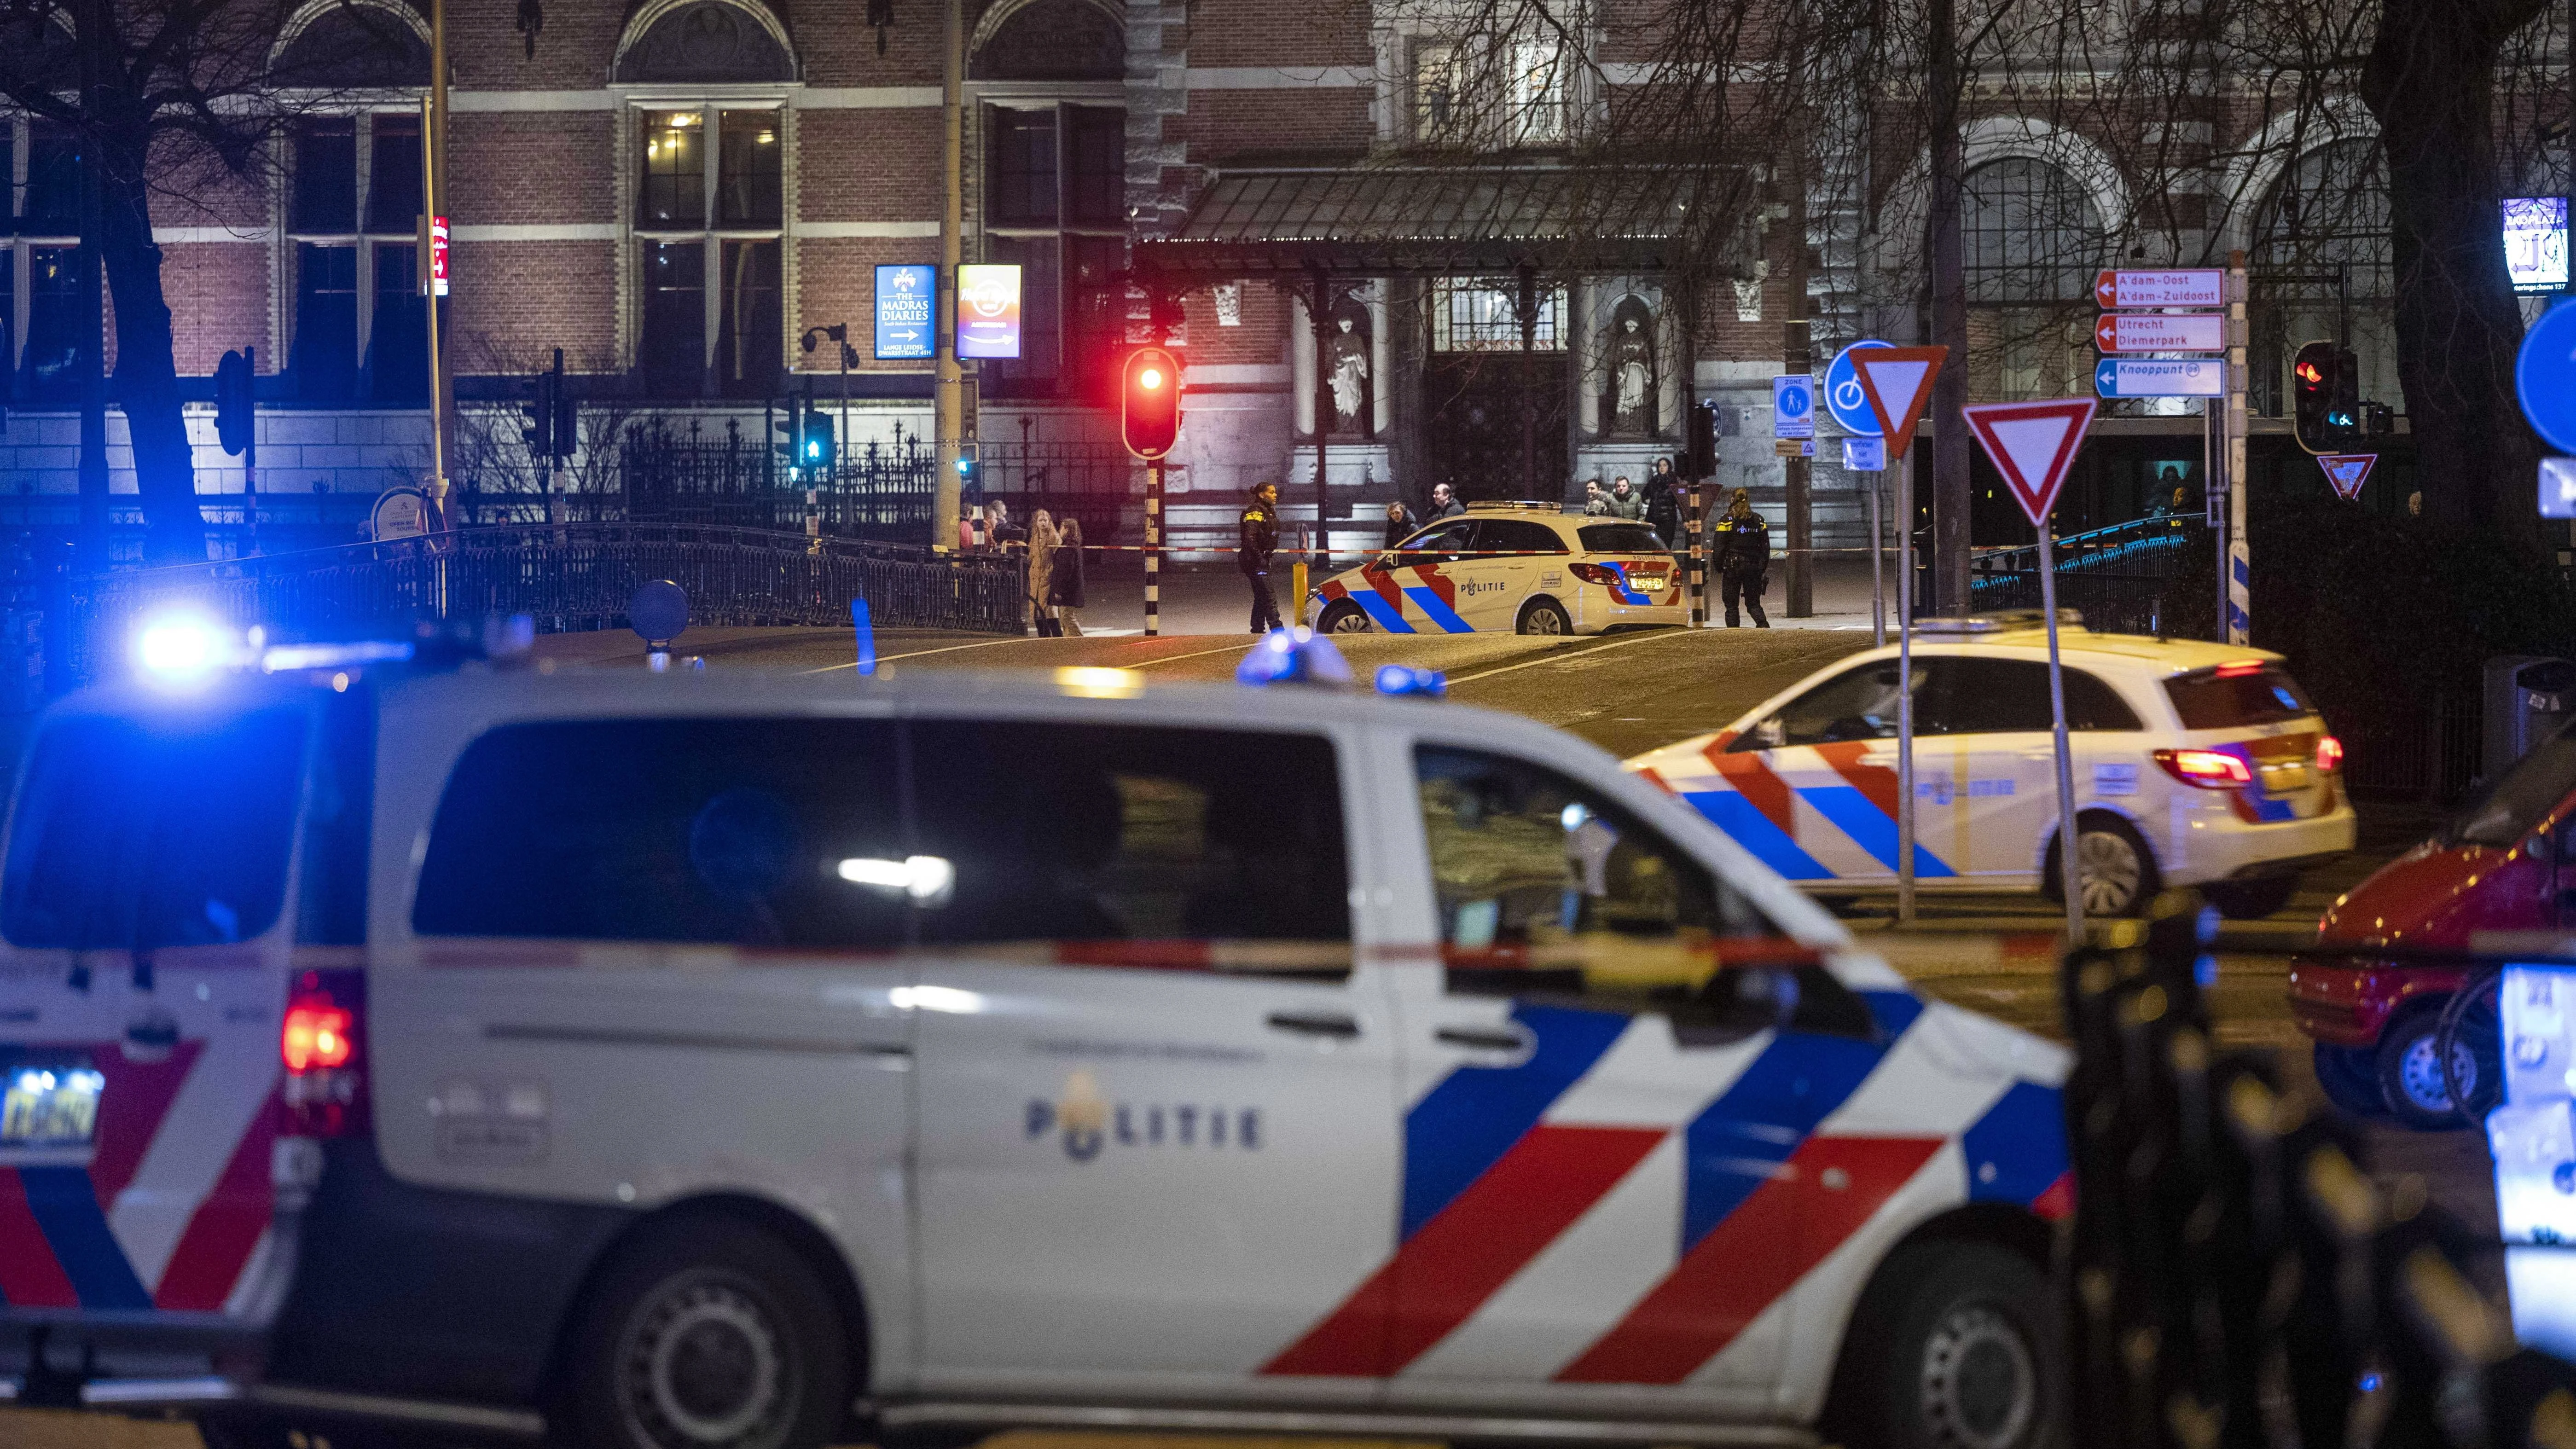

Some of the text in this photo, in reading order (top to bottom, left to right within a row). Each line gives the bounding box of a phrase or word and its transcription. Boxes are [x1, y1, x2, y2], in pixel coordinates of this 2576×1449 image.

[2506, 214, 2563, 226] EKOPLAZA
[2119, 275, 2189, 285] A'dam-Oost
[2119, 291, 2215, 301] A'dam-Zuidoost
[882, 301, 928, 310] MADRAS
[882, 311, 928, 320] DIARIES
[2118, 320, 2164, 329] Utrecht
[2119, 336, 2187, 346] Diemerpark
[2119, 365, 2182, 376] Knooppunt
[1461, 580, 1505, 596] POLITIE
[1023, 1097, 1263, 1162] POLITIE
